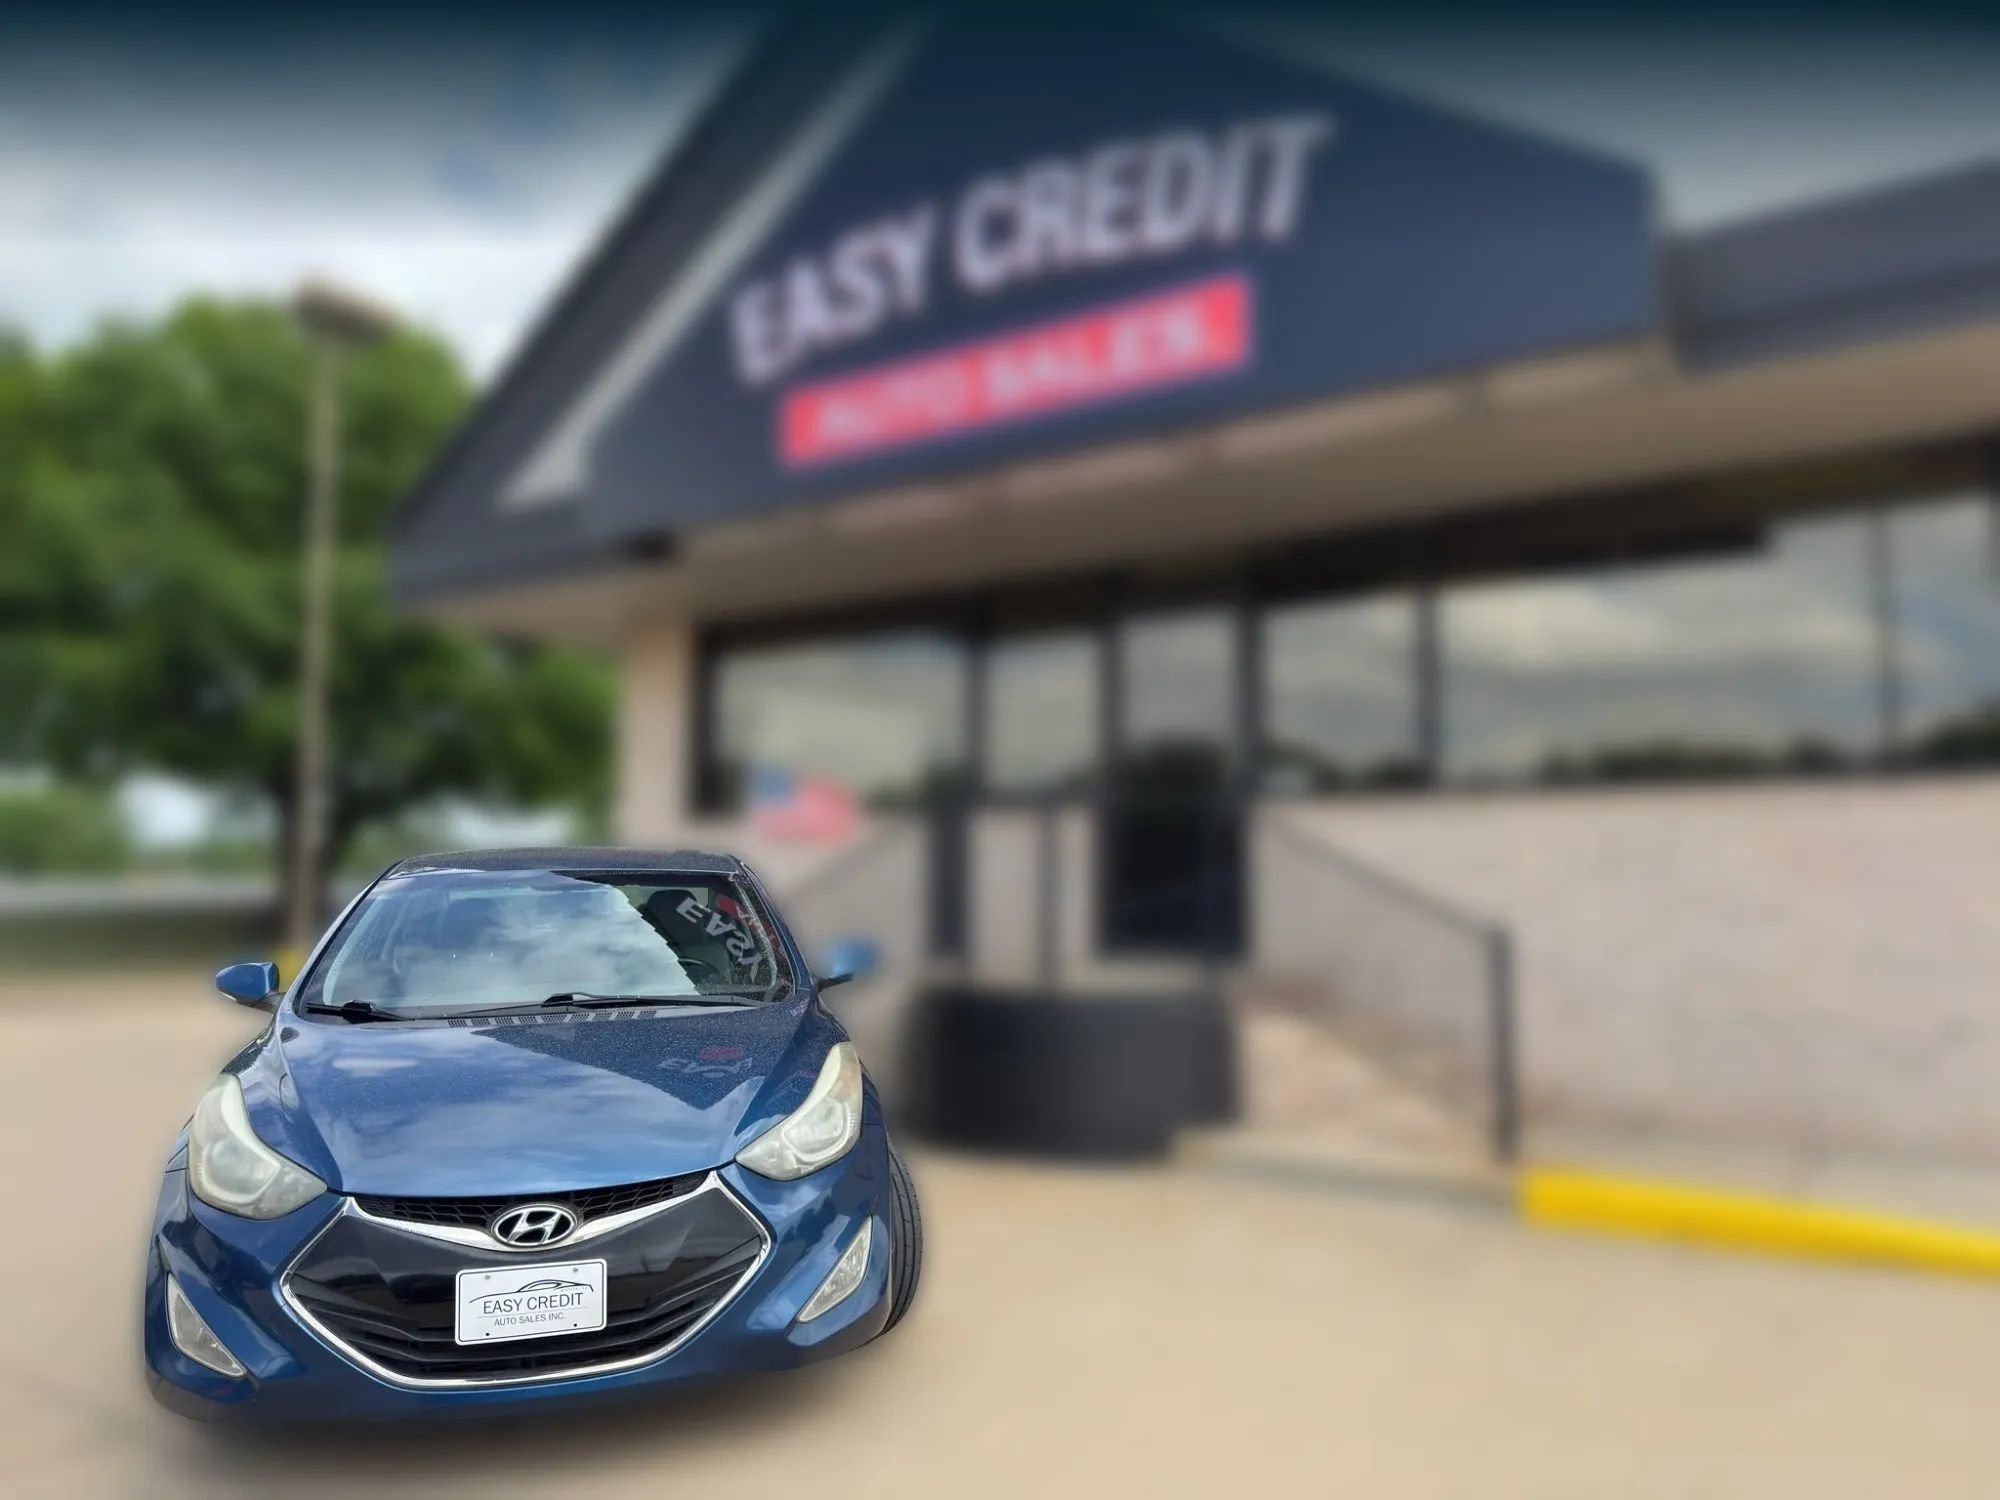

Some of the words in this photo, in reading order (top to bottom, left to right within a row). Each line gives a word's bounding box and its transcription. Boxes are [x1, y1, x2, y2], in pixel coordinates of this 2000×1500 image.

[732, 206, 935, 382] EASY
[955, 115, 1332, 290] CREDIT
[483, 1297, 524, 1315] EASY
[526, 1292, 584, 1311] CREDIT
[493, 1316, 517, 1326] AUTO
[519, 1313, 547, 1324] SALES
[548, 1312, 565, 1321] INC.
